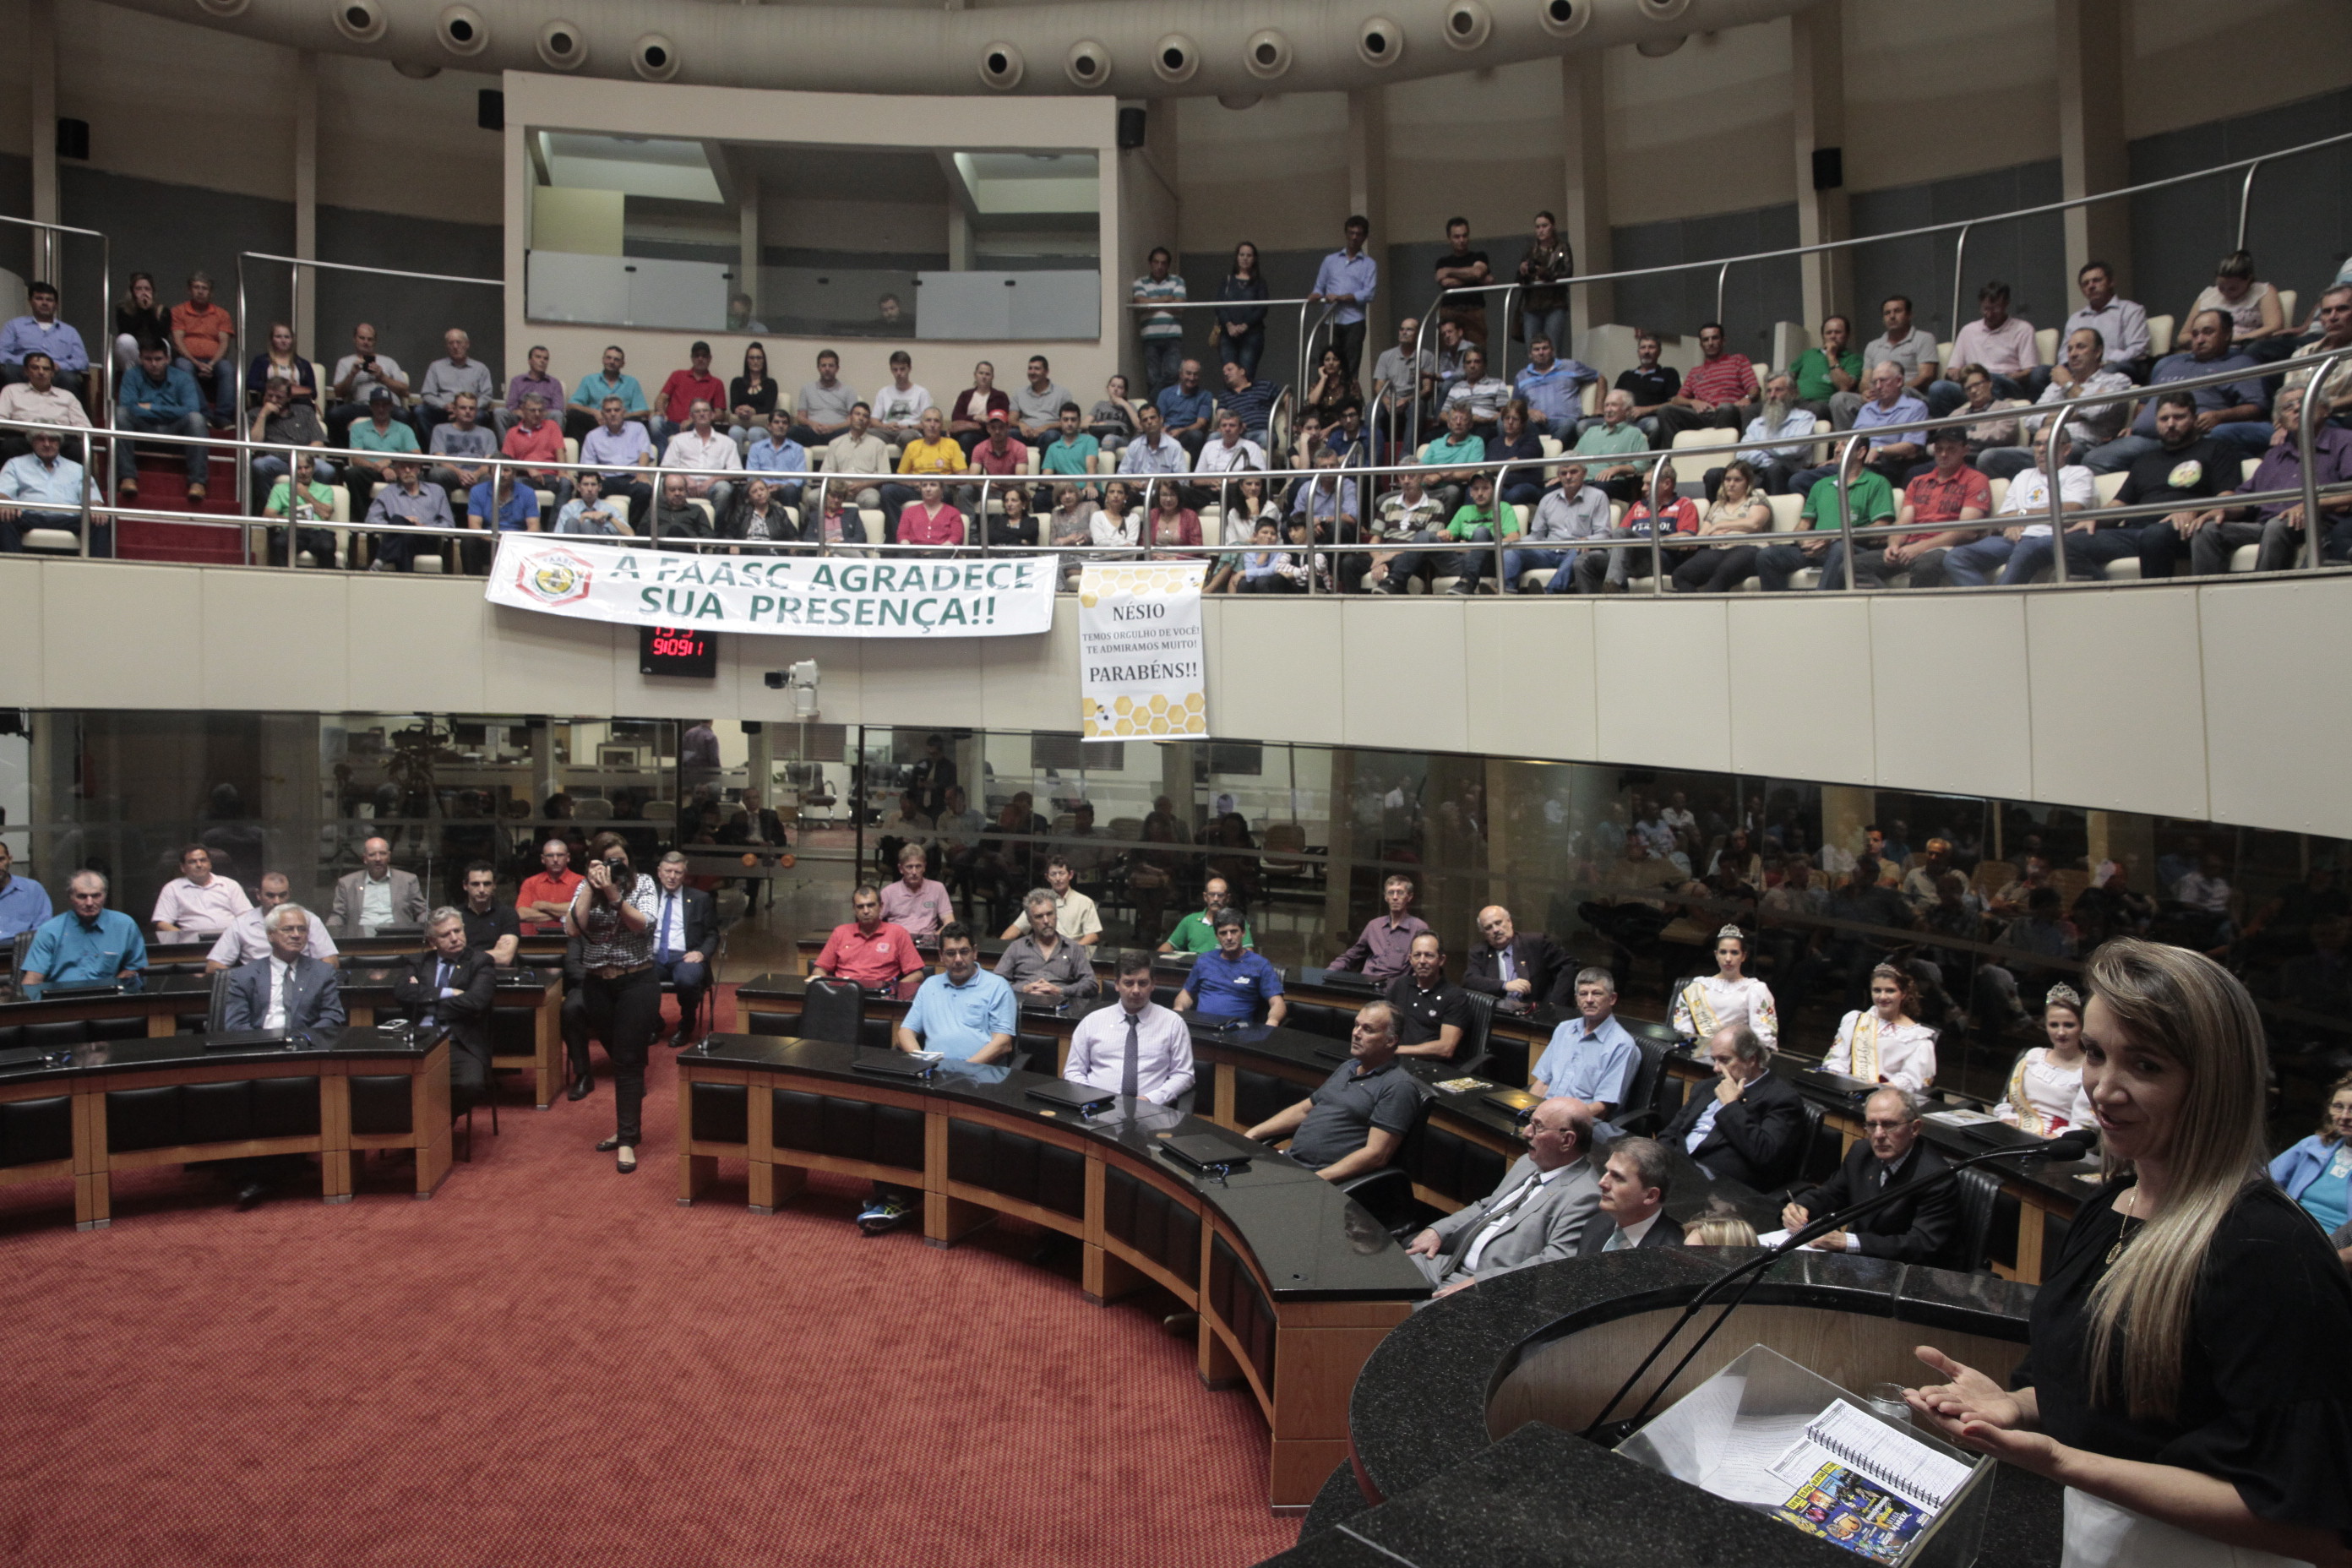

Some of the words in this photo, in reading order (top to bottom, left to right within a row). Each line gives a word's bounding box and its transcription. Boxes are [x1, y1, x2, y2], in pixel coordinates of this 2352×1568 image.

[610, 556, 640, 580] A
[657, 558, 792, 589] FAASC
[808, 563, 1036, 592] AGRADECE
[639, 586, 725, 620] SUA
[749, 595, 995, 634] PRESENÇA!!
[1113, 601, 1165, 621] NÉSIO
[1082, 632, 1111, 641] TEMOS
[1113, 629, 1157, 640] ORGULHO
[1159, 629, 1171, 637] DE
[1173, 625, 1200, 635] VOCÊ!
[1086, 645, 1098, 654] TE
[1100, 641, 1159, 654] ADMIRAMOS
[1162, 640, 1197, 650] MUITO!
[1089, 659, 1197, 683] PARABÉNS!!
